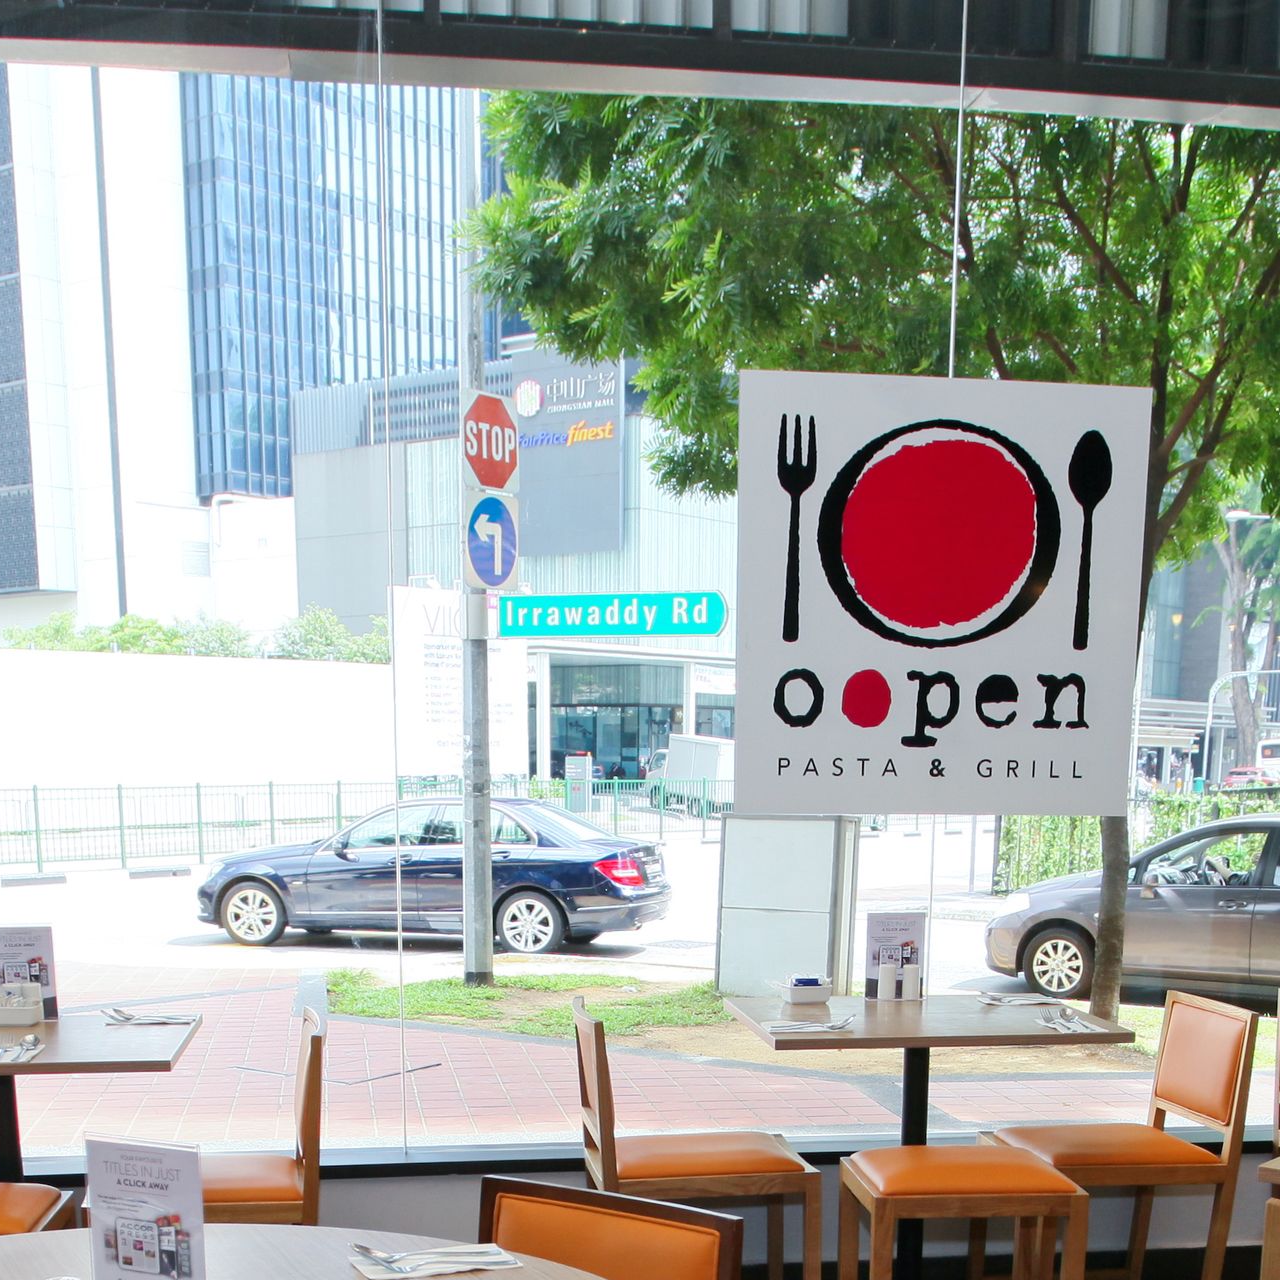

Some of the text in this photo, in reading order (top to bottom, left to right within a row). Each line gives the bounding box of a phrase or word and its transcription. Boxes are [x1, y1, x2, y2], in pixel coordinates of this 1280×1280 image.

[465, 420, 515, 463] STOP
[506, 597, 708, 631] Irrawaddy Rd
[777, 757, 1083, 779] PASTA & GRILL
[103, 1160, 181, 1182] TITLES IN JUST
[123, 1178, 146, 1188] CLICK
[148, 1182, 169, 1190] AWAY
